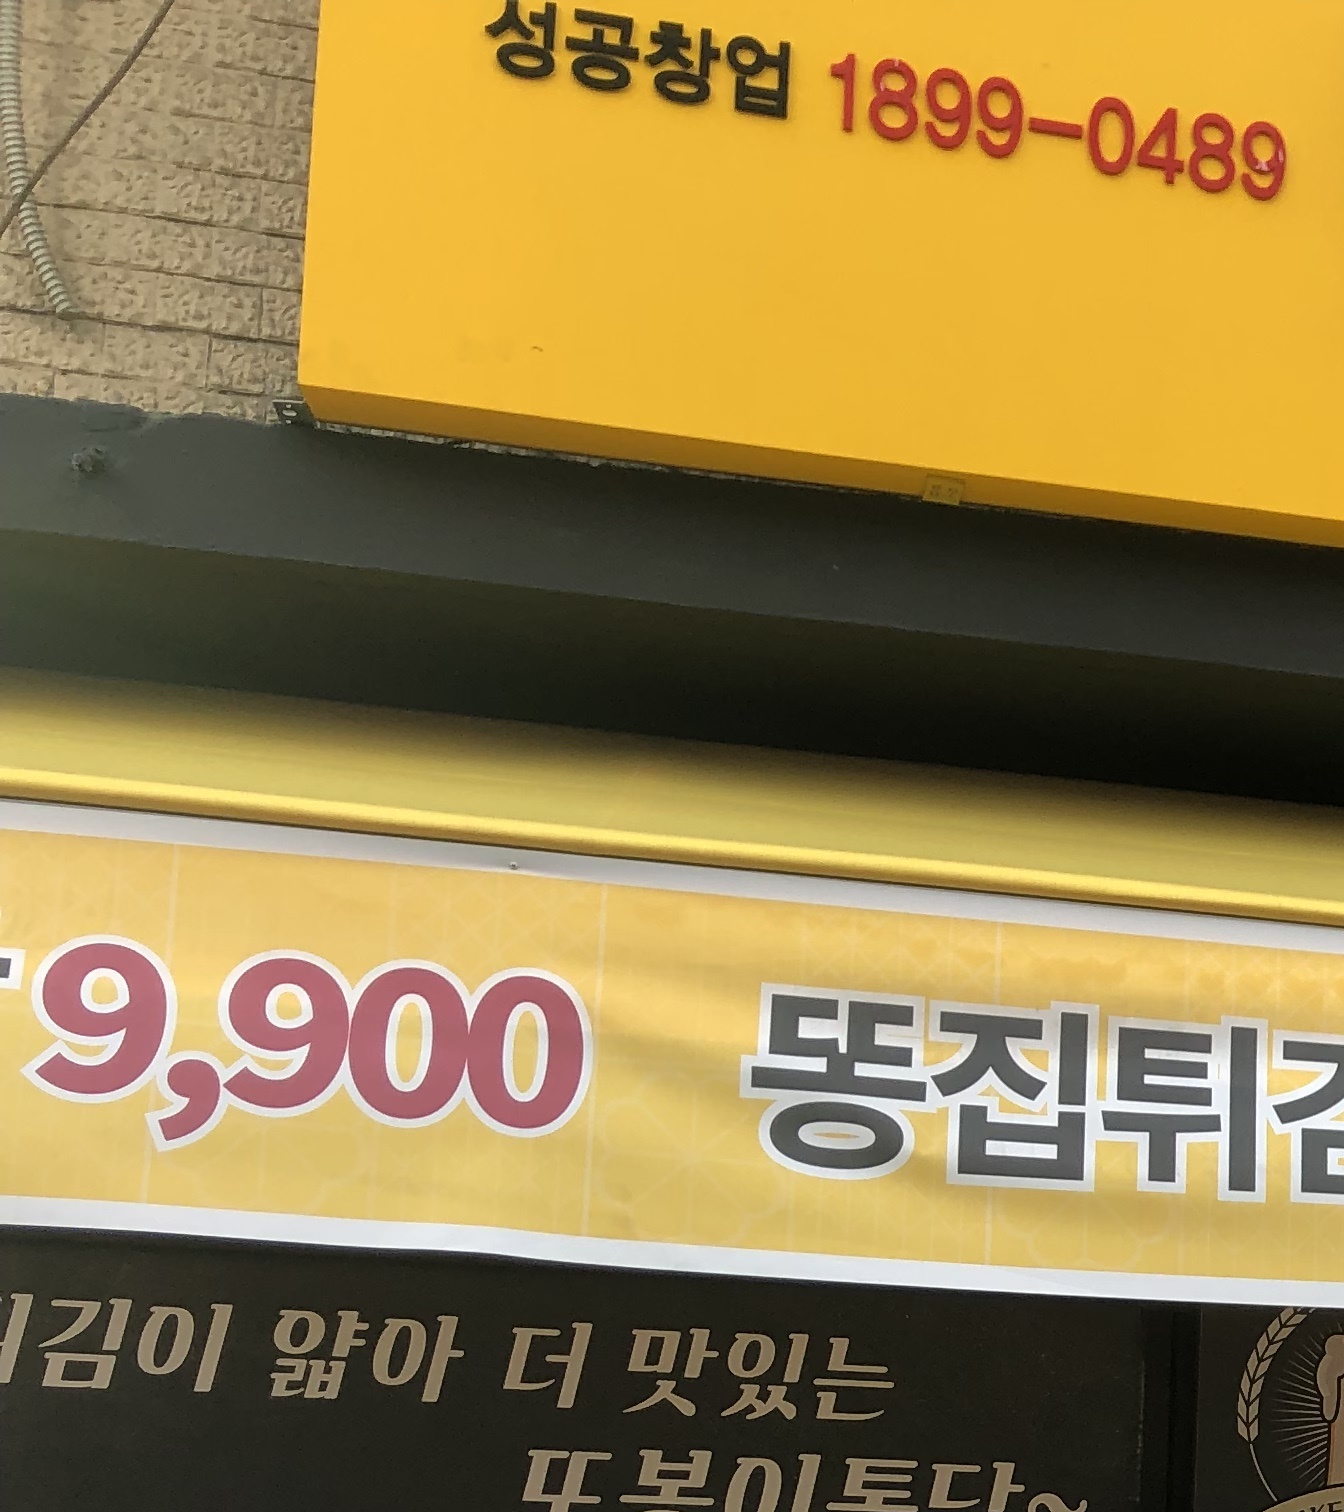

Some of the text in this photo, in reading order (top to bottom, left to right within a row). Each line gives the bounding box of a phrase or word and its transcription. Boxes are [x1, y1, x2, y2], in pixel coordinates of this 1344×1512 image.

[485, 0, 1288, 202] 성공창업 1899-0489
[32, 941, 586, 1145] 9,900
[269, 1306, 465, 1403] 얇아
[503, 1321, 595, 1409] 더
[621, 1327, 897, 1423] 맛있는
